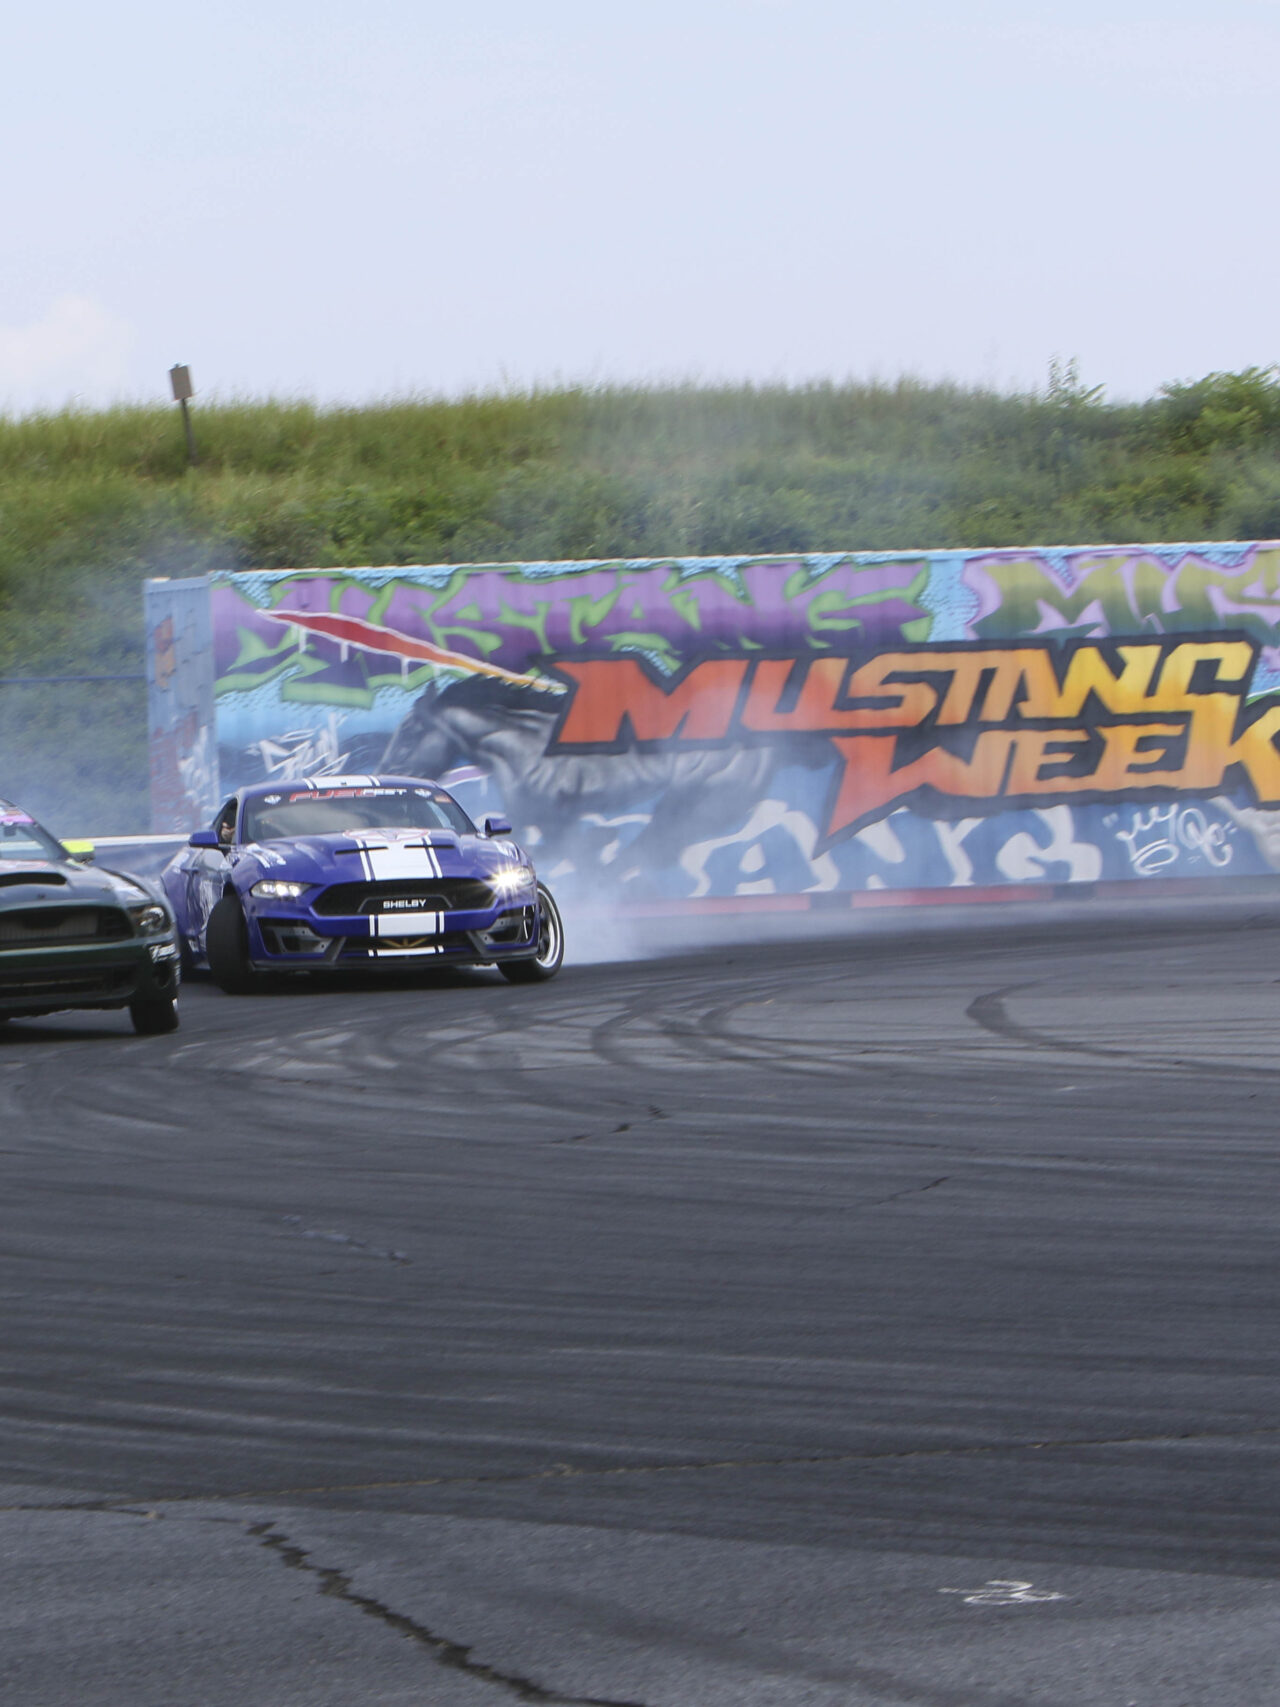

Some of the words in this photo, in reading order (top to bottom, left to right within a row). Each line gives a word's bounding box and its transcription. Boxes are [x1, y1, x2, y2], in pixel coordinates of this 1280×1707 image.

[550, 641, 1254, 743] MUSTANG
[828, 705, 1280, 838] WEEK
[383, 899, 426, 909] SHELBY
